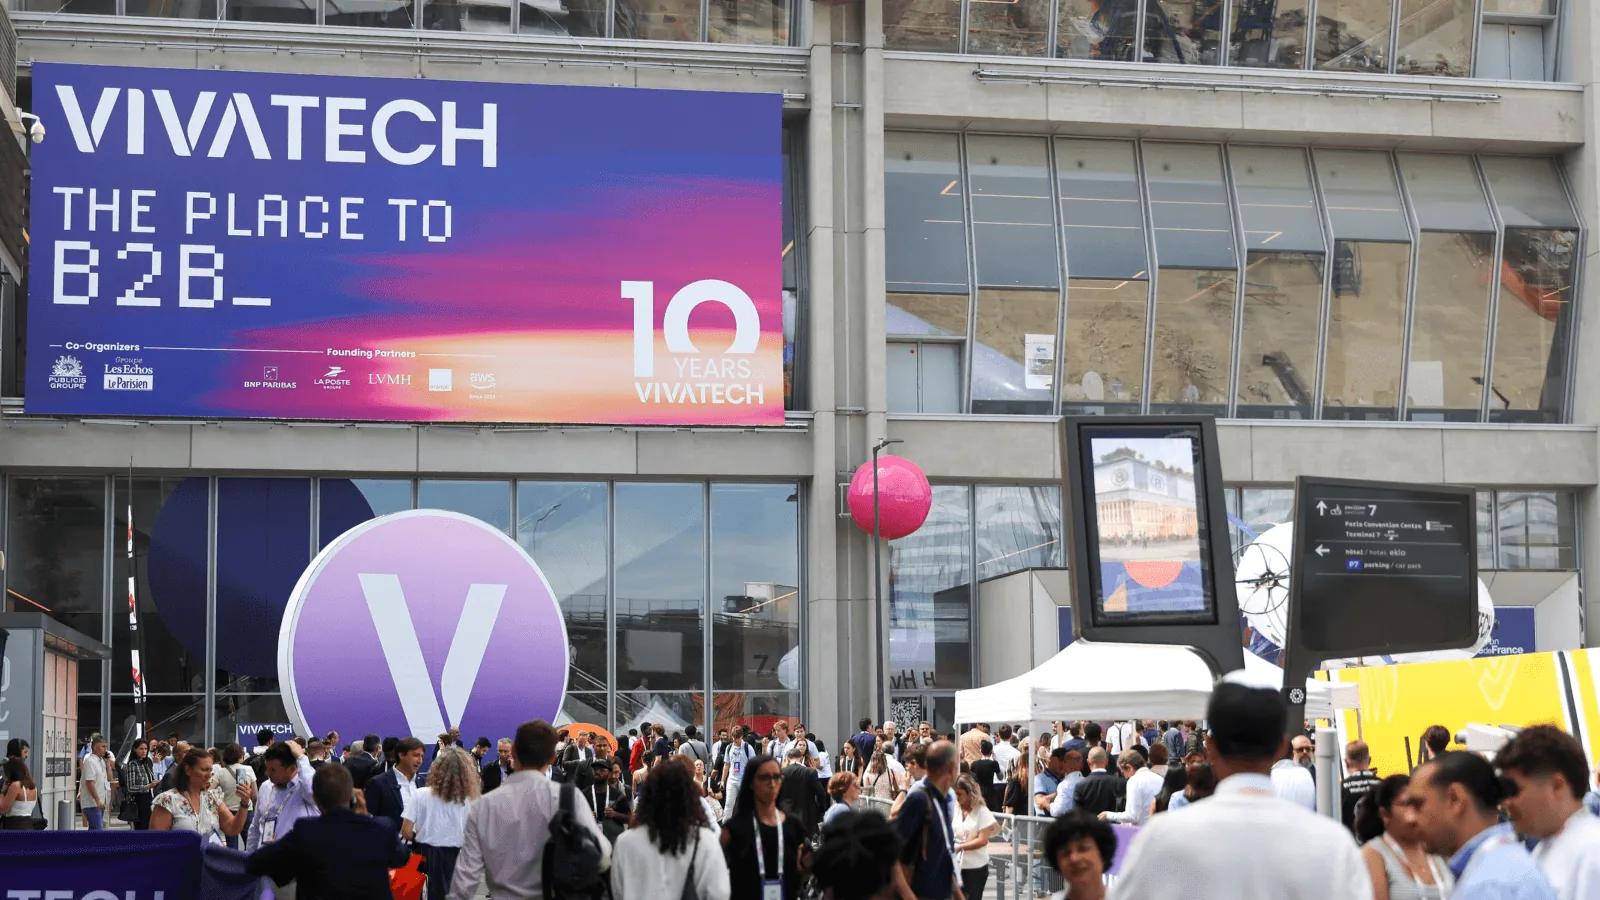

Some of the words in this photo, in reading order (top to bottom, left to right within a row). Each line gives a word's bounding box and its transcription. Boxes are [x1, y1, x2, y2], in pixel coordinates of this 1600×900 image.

[55, 84, 498, 168] VIVATECH
[52, 186, 157, 233] THE
[186, 191, 365, 240] PLACE
[387, 198, 452, 243] TO
[620, 279, 761, 377] 10
[65, 342, 140, 353] Co-Organizers
[327, 348, 373, 359] Founding
[375, 349, 416, 359] Partners
[115, 356, 143, 364] Groupe
[104, 364, 122, 374] Les
[123, 364, 153, 374] Echos
[673, 357, 752, 379] YEARS
[108, 379, 116, 389] Le
[117, 377, 148, 389] Parisien
[368, 374, 411, 385] LVMH
[470, 373, 495, 382] aws
[633, 382, 764, 405] VIVATECH
[1368, 504, 1377, 516] 7
[1364, 562, 1390, 570] parking
[357, 573, 508, 744] V
